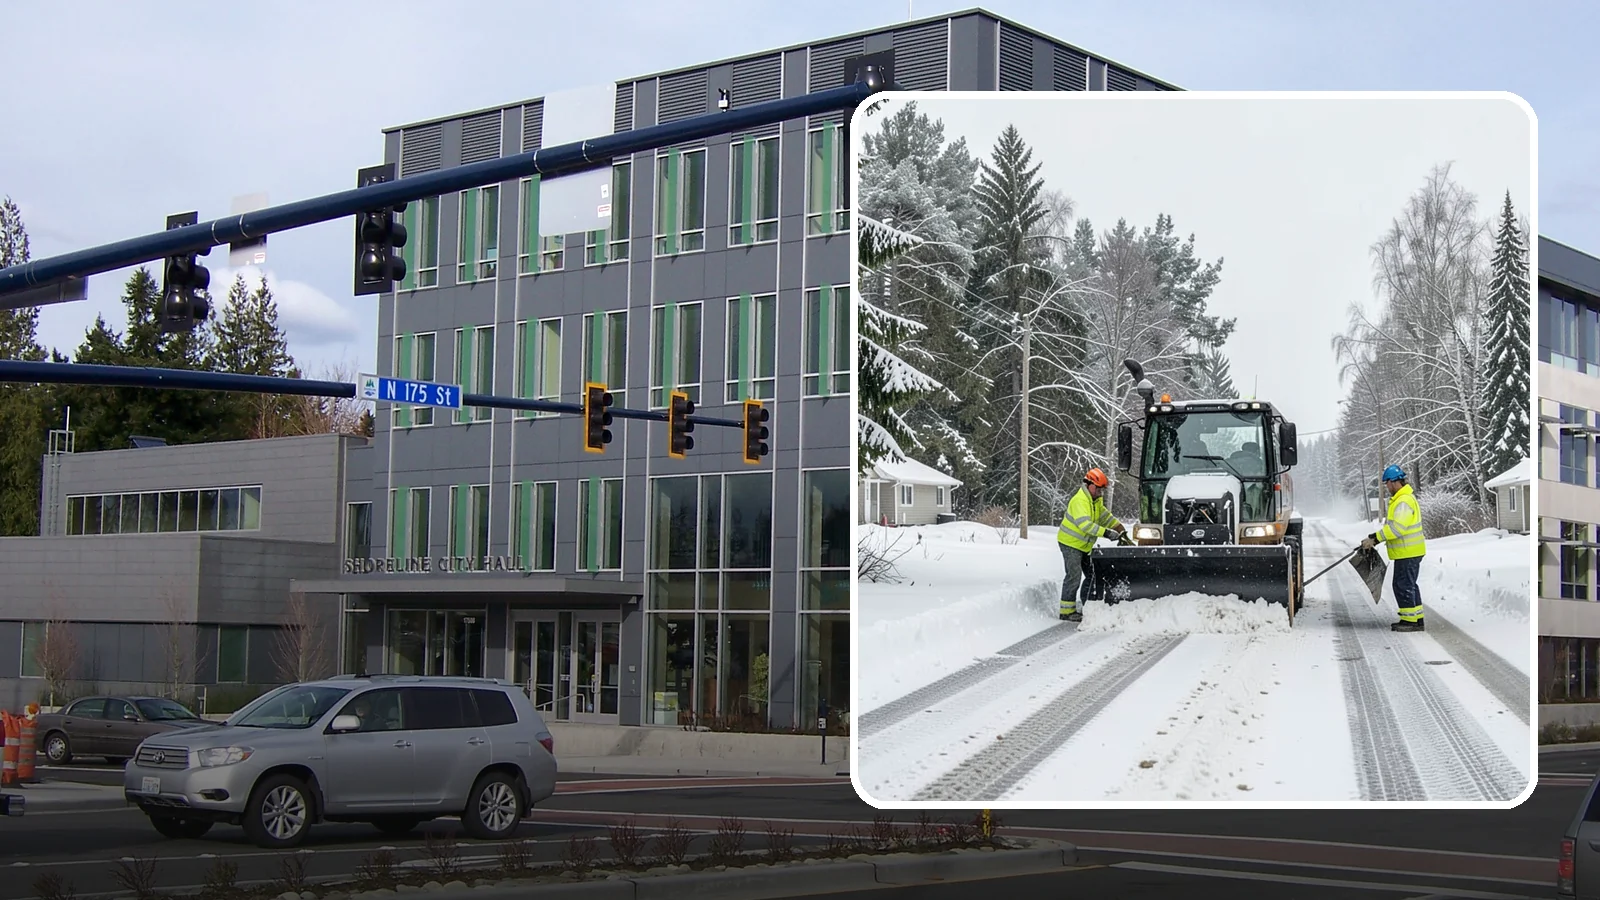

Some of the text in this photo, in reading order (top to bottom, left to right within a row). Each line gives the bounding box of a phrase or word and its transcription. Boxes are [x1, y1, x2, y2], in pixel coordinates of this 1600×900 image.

[387, 380, 452, 406] N 175 St
[344, 556, 526, 574] SHORELINE CITY HALL
